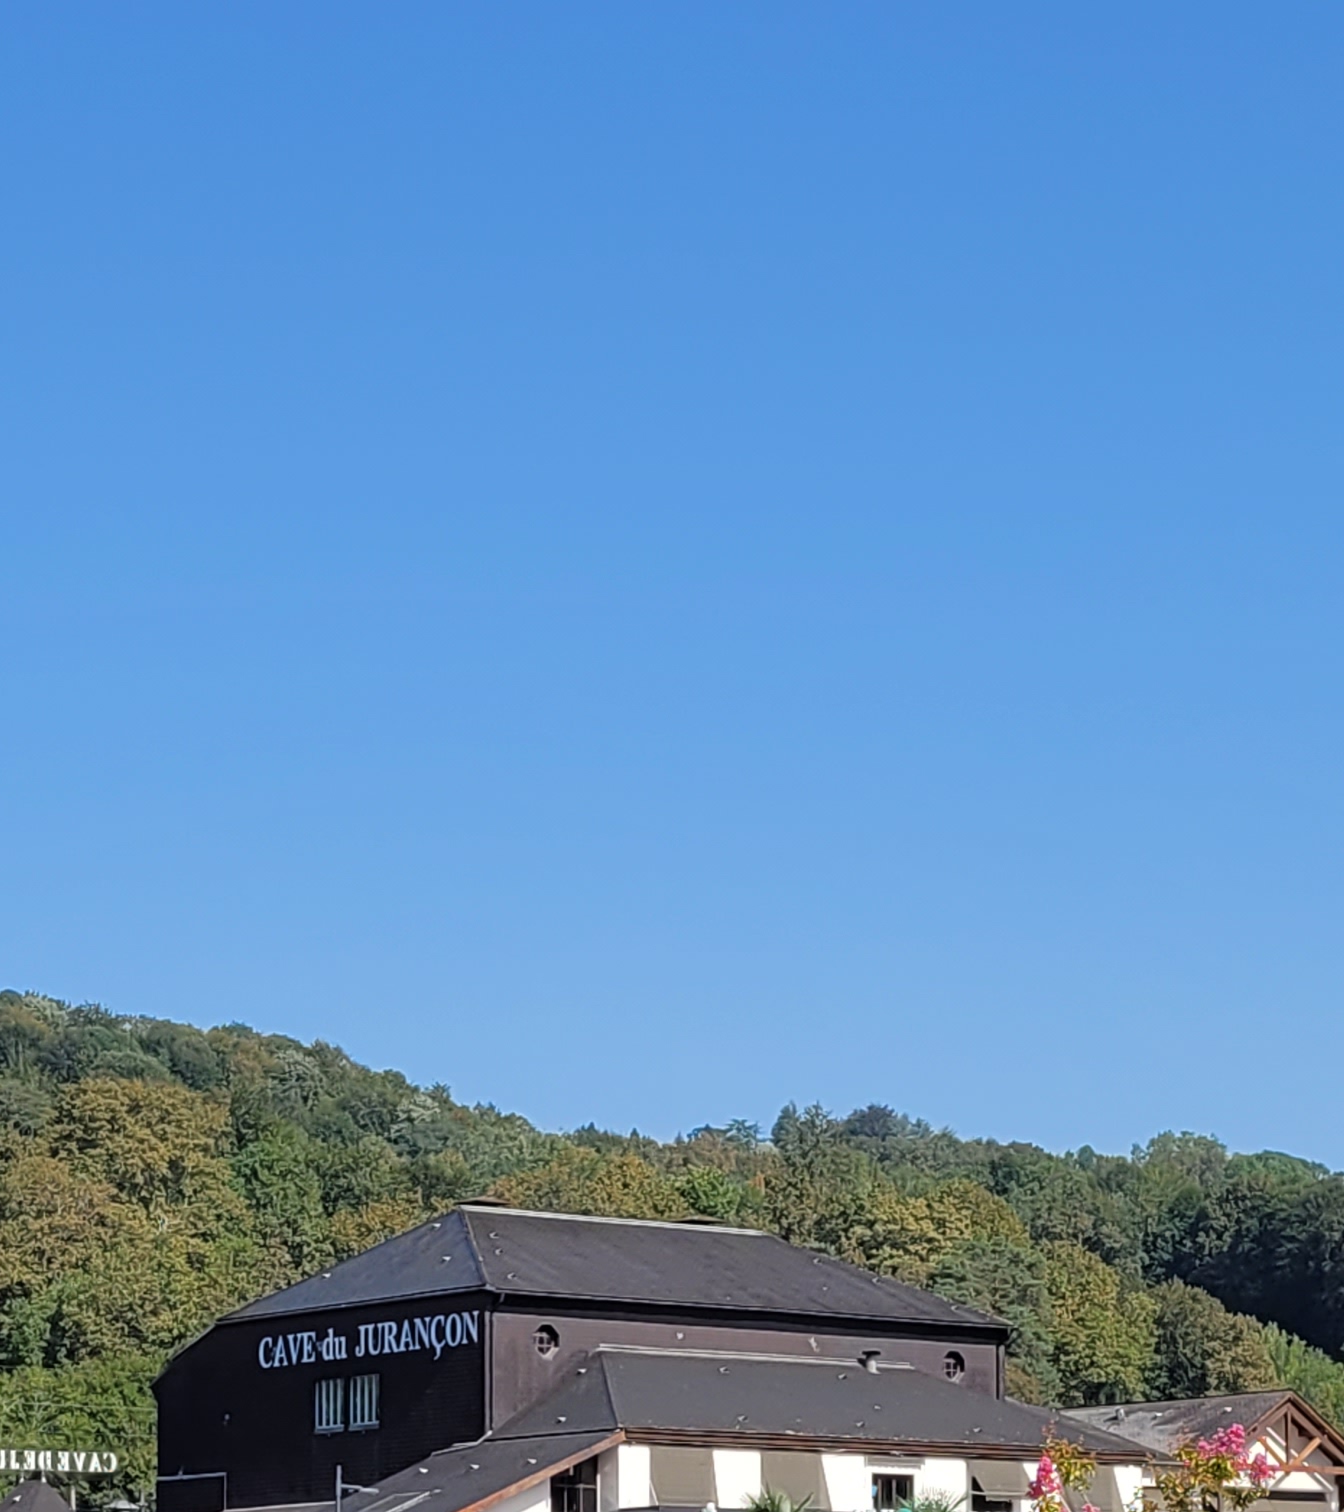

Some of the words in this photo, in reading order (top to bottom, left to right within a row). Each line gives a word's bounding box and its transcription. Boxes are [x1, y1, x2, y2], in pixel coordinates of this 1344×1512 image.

[258, 1331, 316, 1369] CAVE
[323, 1327, 348, 1361] du
[354, 1310, 480, 1361] JURANÇON
